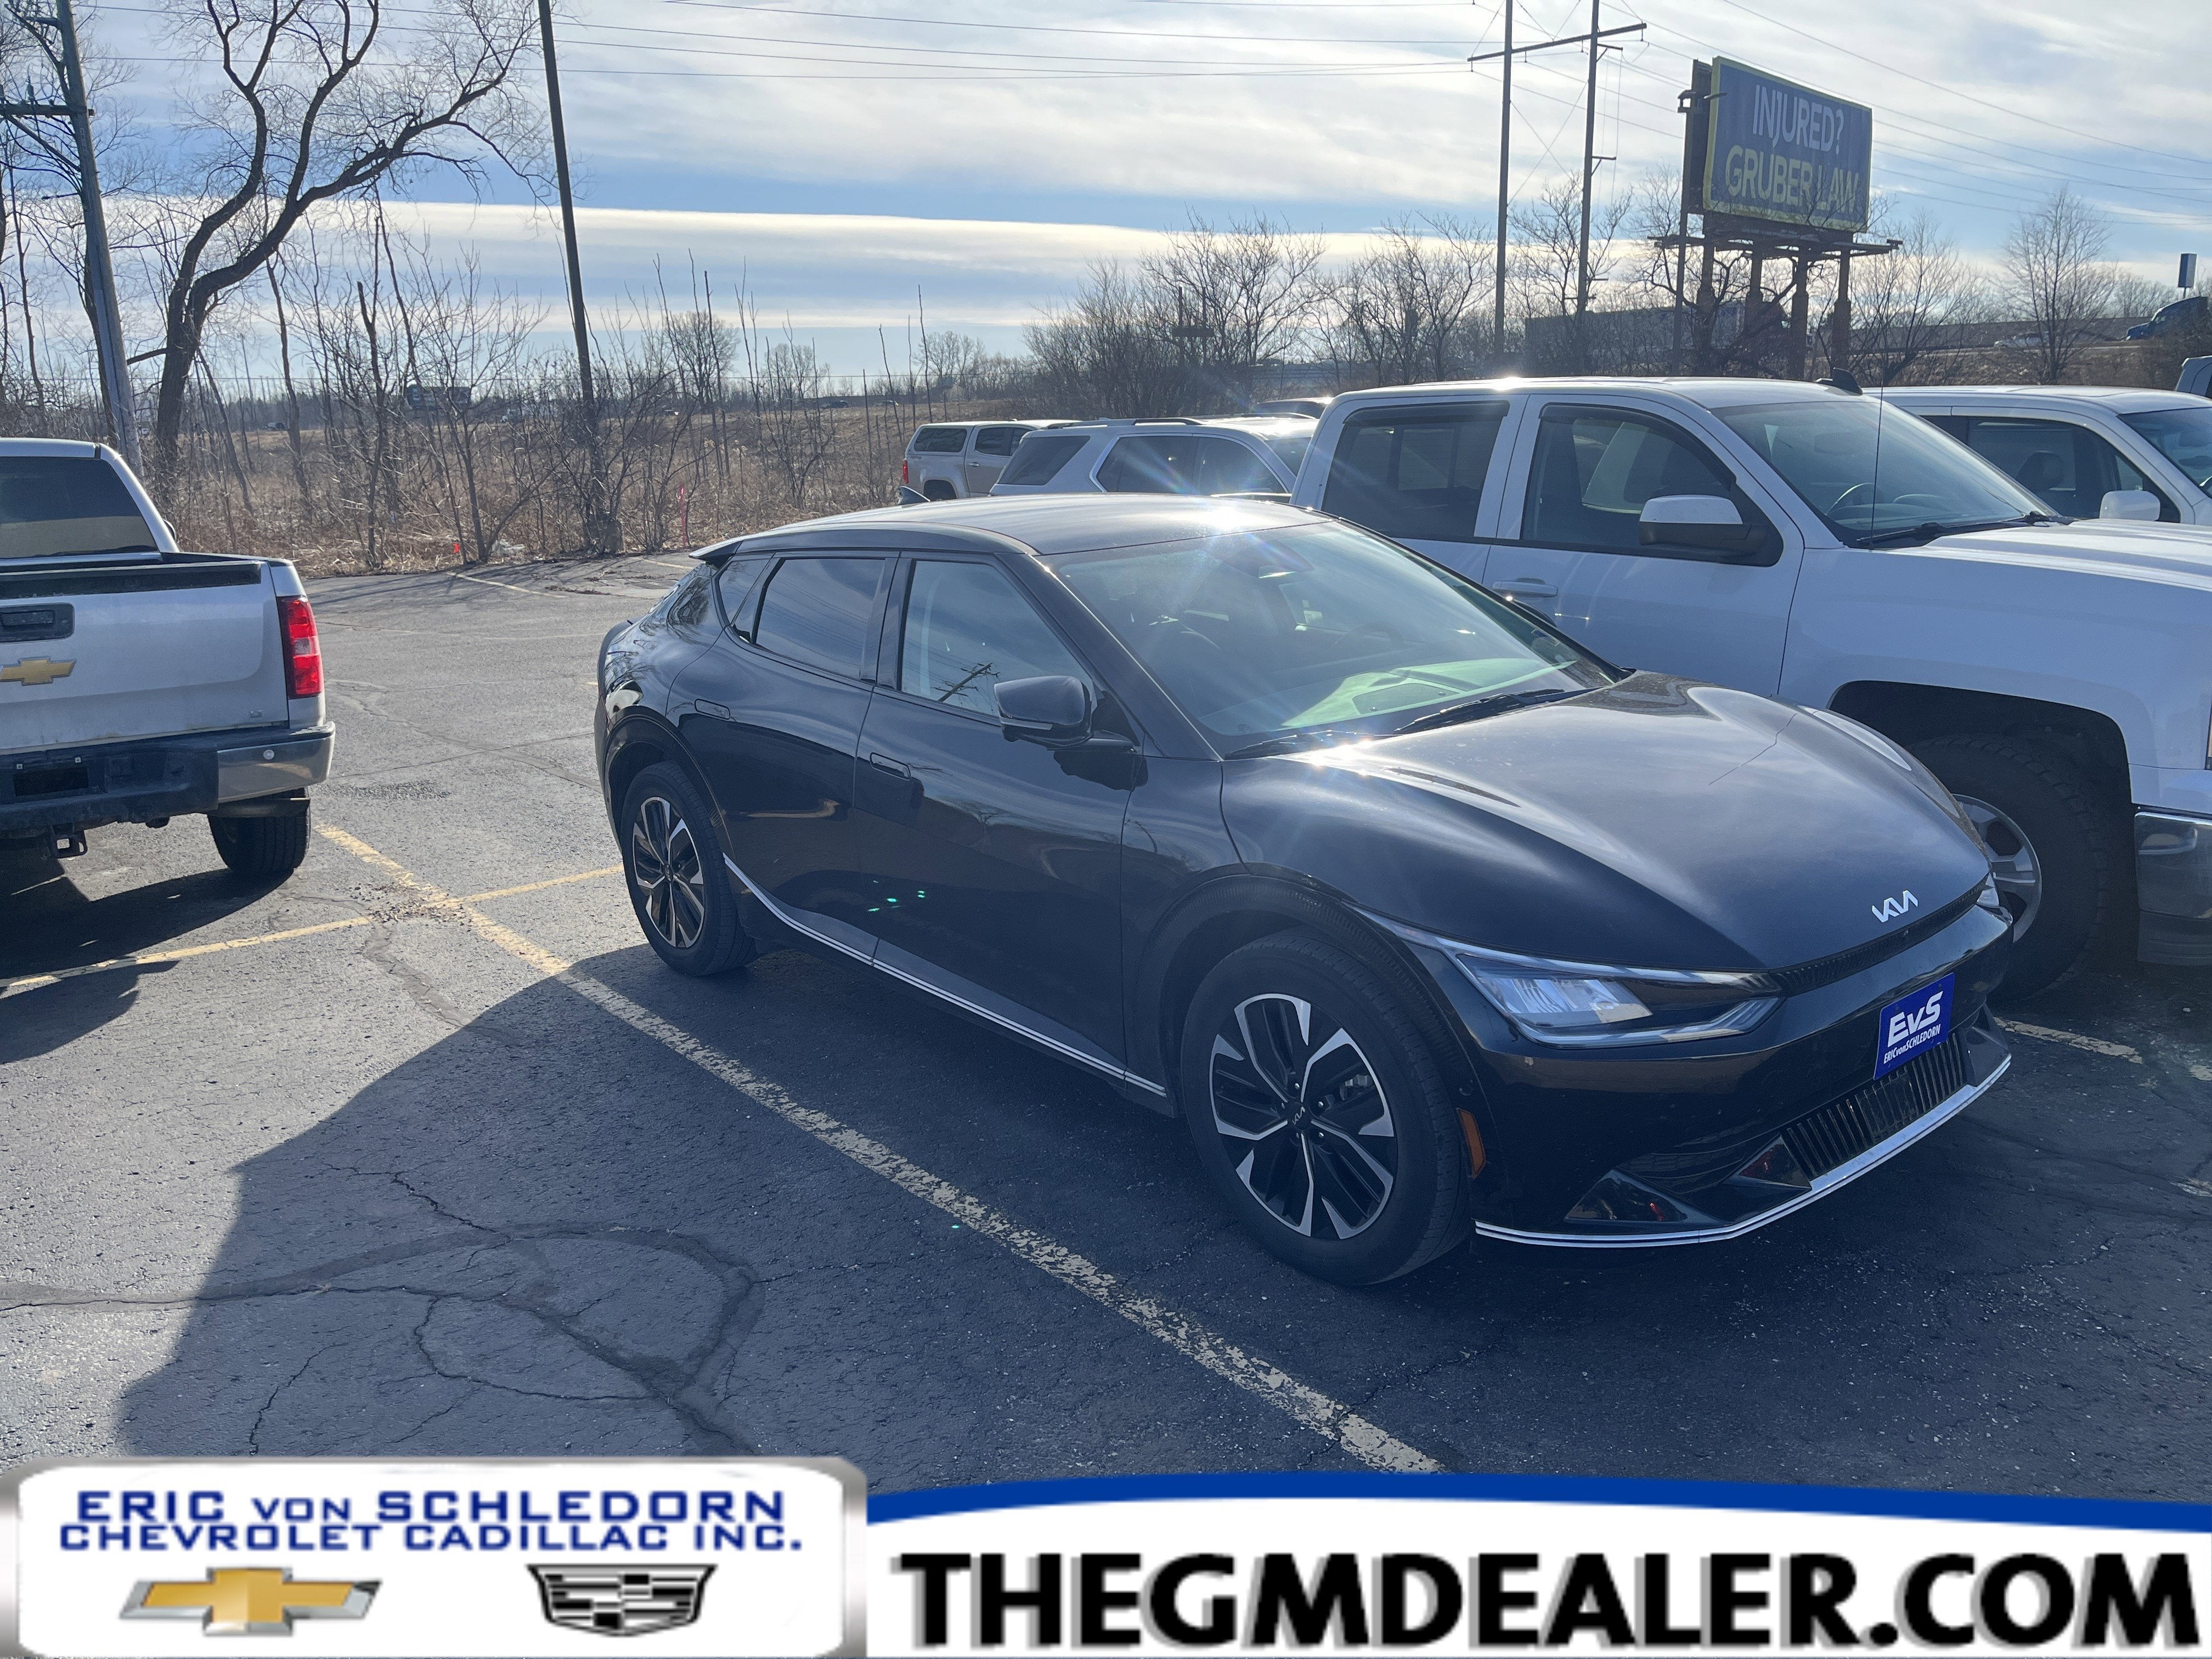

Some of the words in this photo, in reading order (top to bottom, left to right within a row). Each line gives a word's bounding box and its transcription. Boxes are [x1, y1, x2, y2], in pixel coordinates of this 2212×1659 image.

[1752, 84, 1844, 155] INJURED?
[1725, 144, 1813, 207] GRUBER
[1815, 165, 1859, 213] LAW
